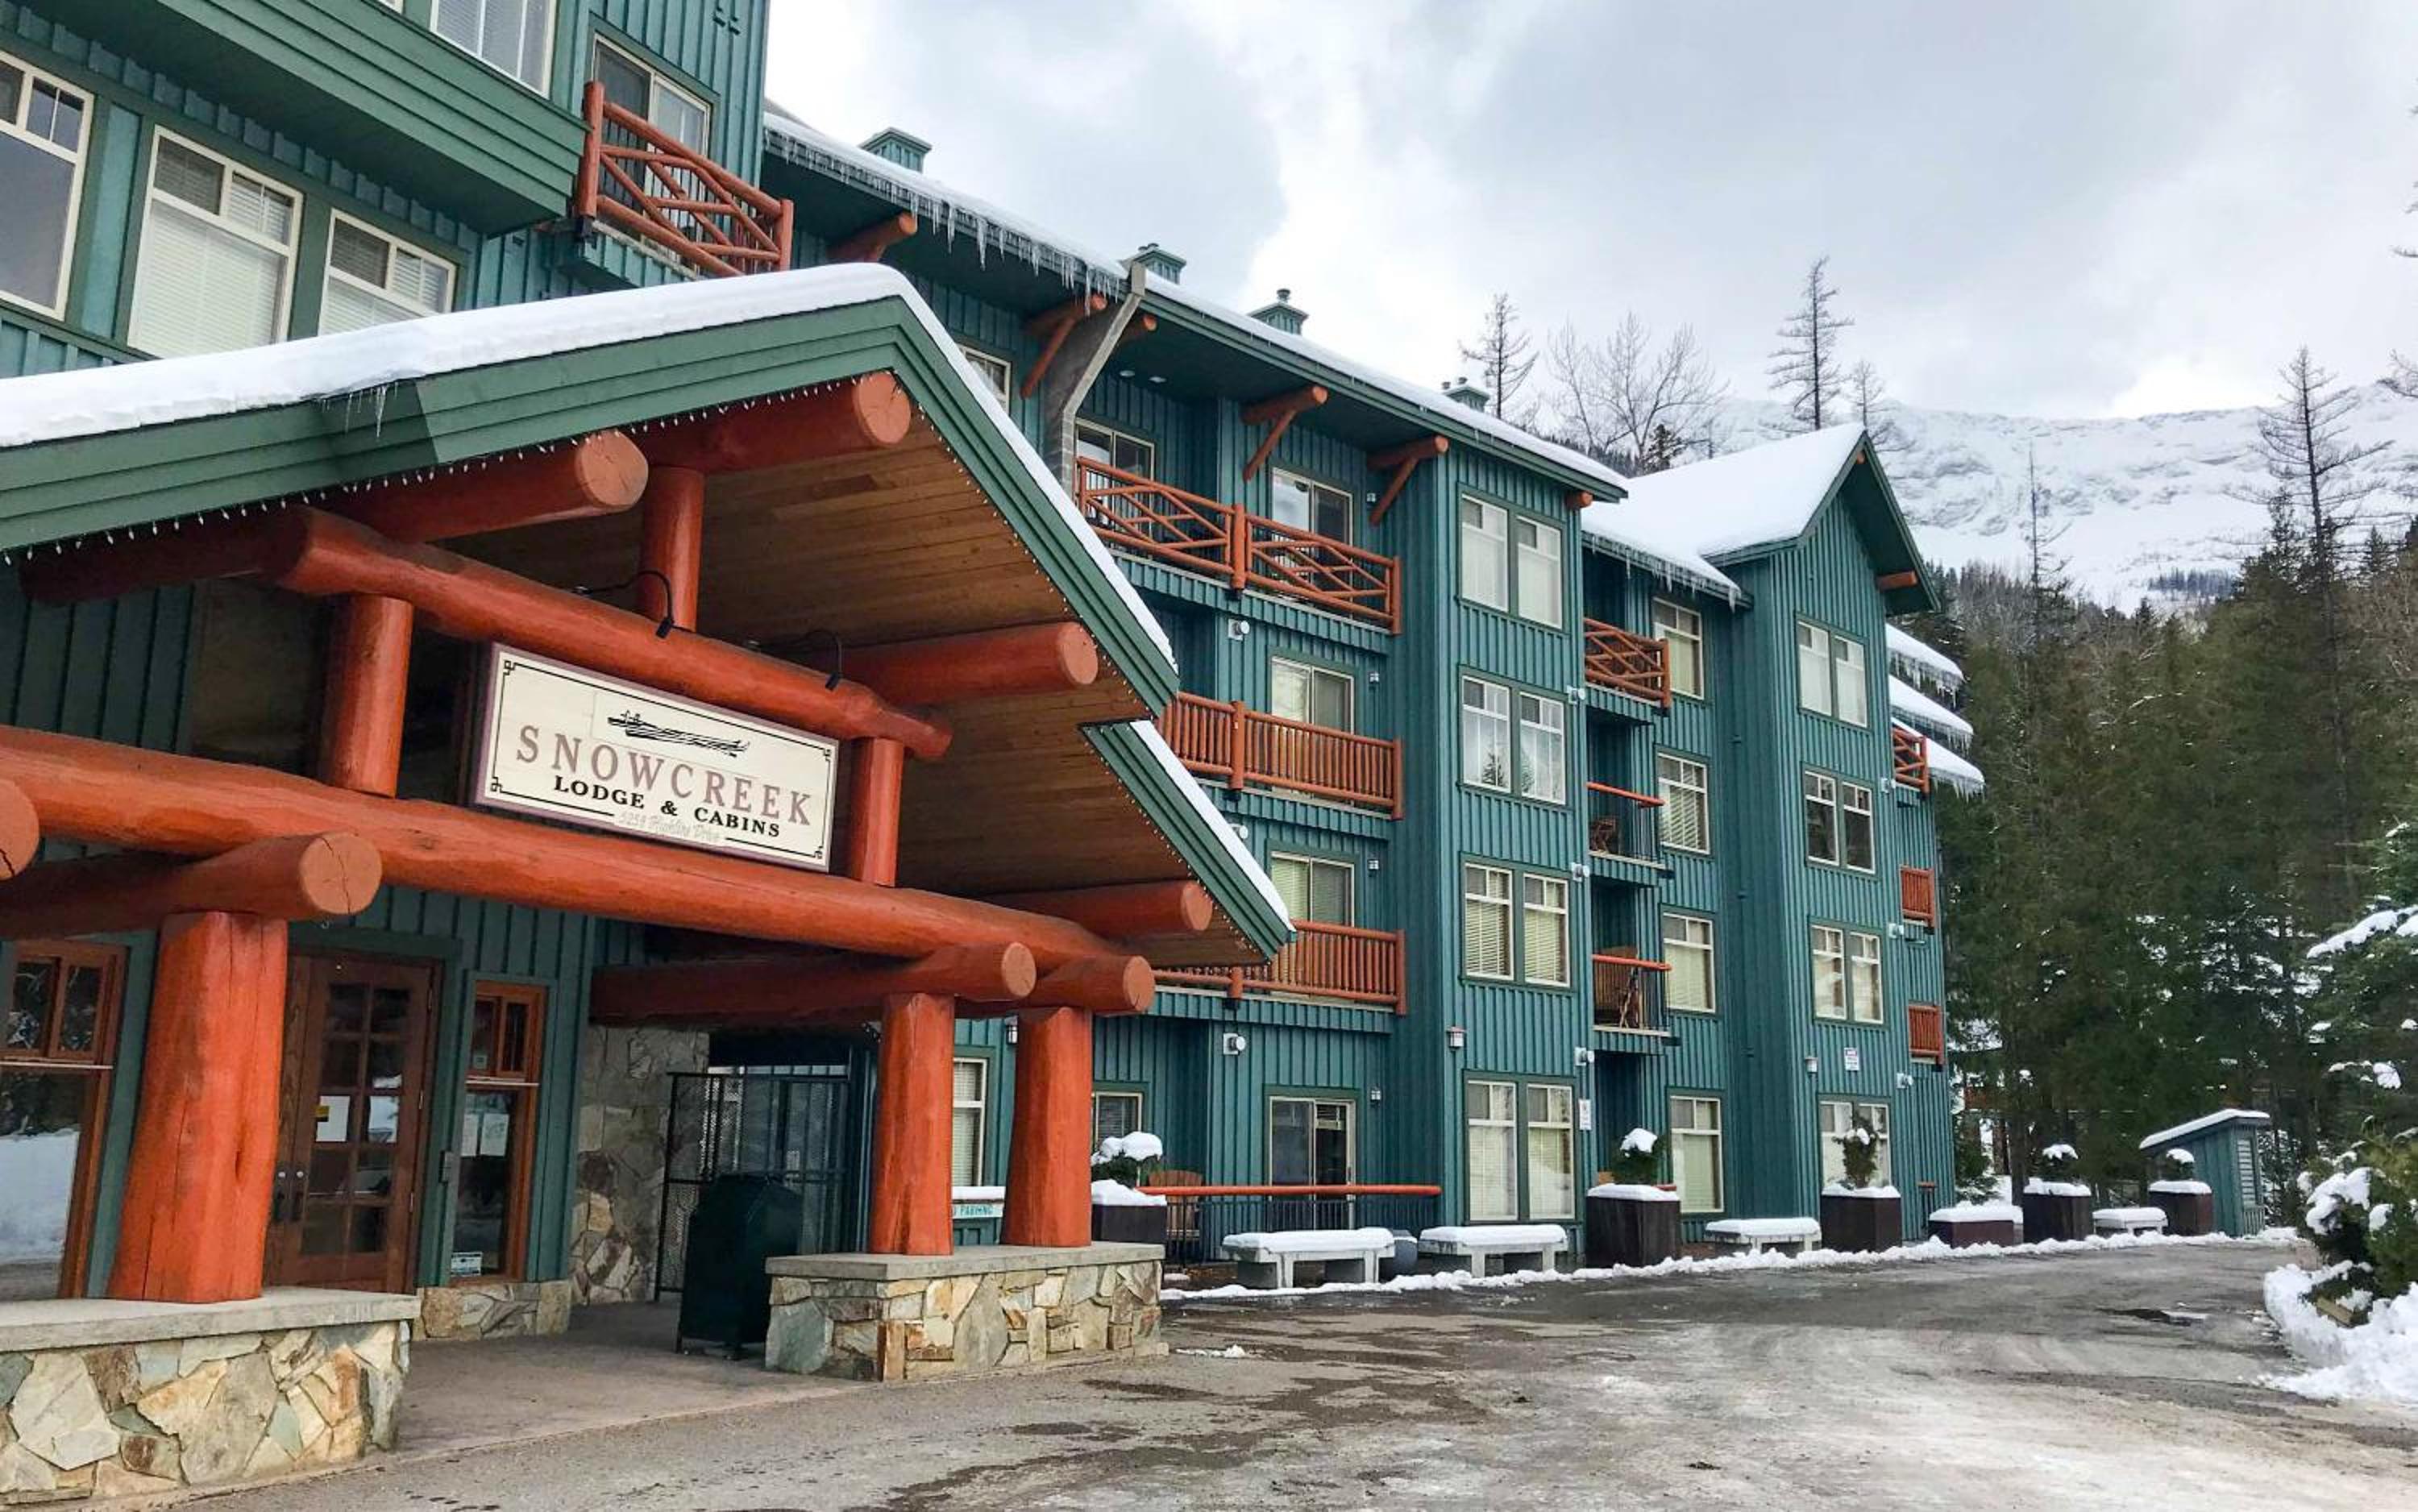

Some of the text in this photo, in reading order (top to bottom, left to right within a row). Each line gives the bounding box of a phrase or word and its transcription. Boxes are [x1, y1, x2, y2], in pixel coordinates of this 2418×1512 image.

[516, 725, 811, 826] SNOWCREEK
[554, 775, 644, 809] LODGE
[660, 800, 679, 816] &
[694, 807, 780, 837] CABINS
